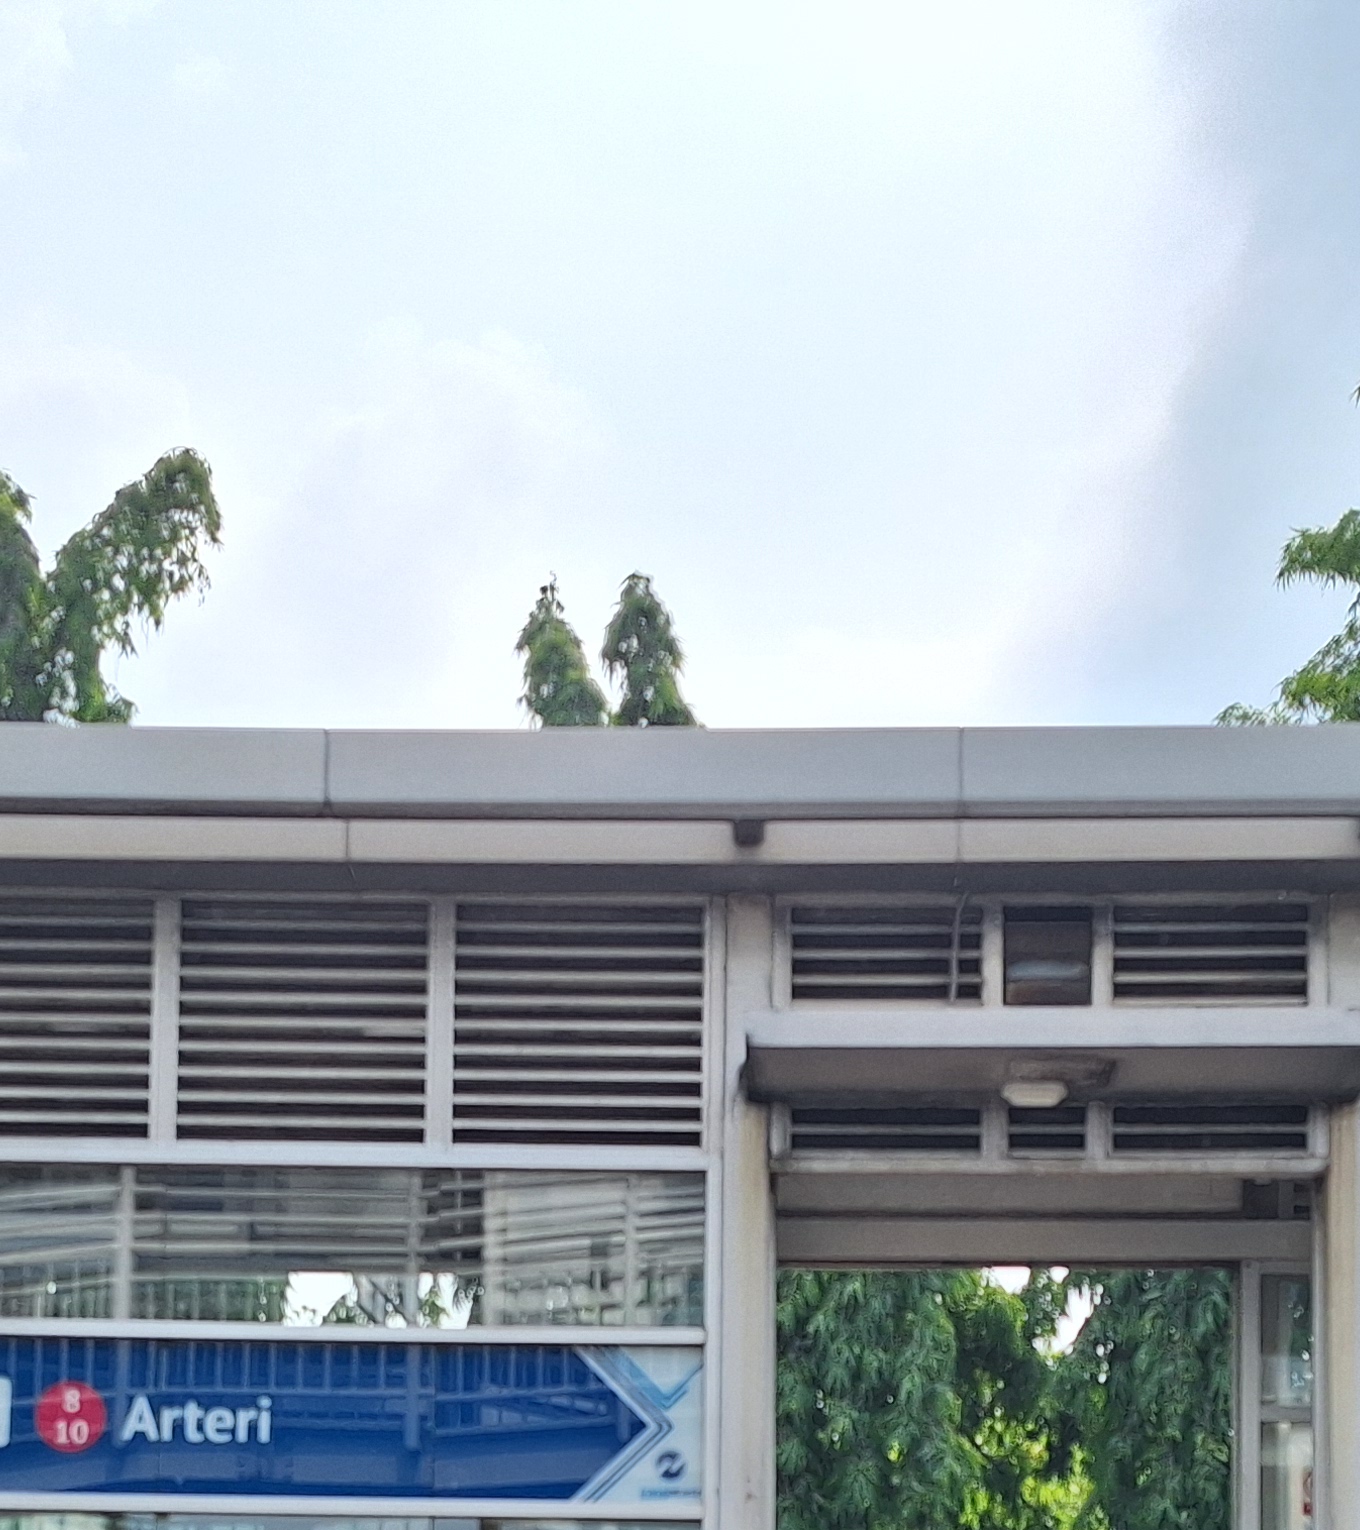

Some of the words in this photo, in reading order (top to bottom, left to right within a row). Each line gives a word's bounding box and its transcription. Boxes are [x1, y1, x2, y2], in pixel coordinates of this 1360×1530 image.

[61, 1388, 81, 1413] 8
[120, 1394, 273, 1444] Arteri
[55, 1420, 90, 1445] 10
